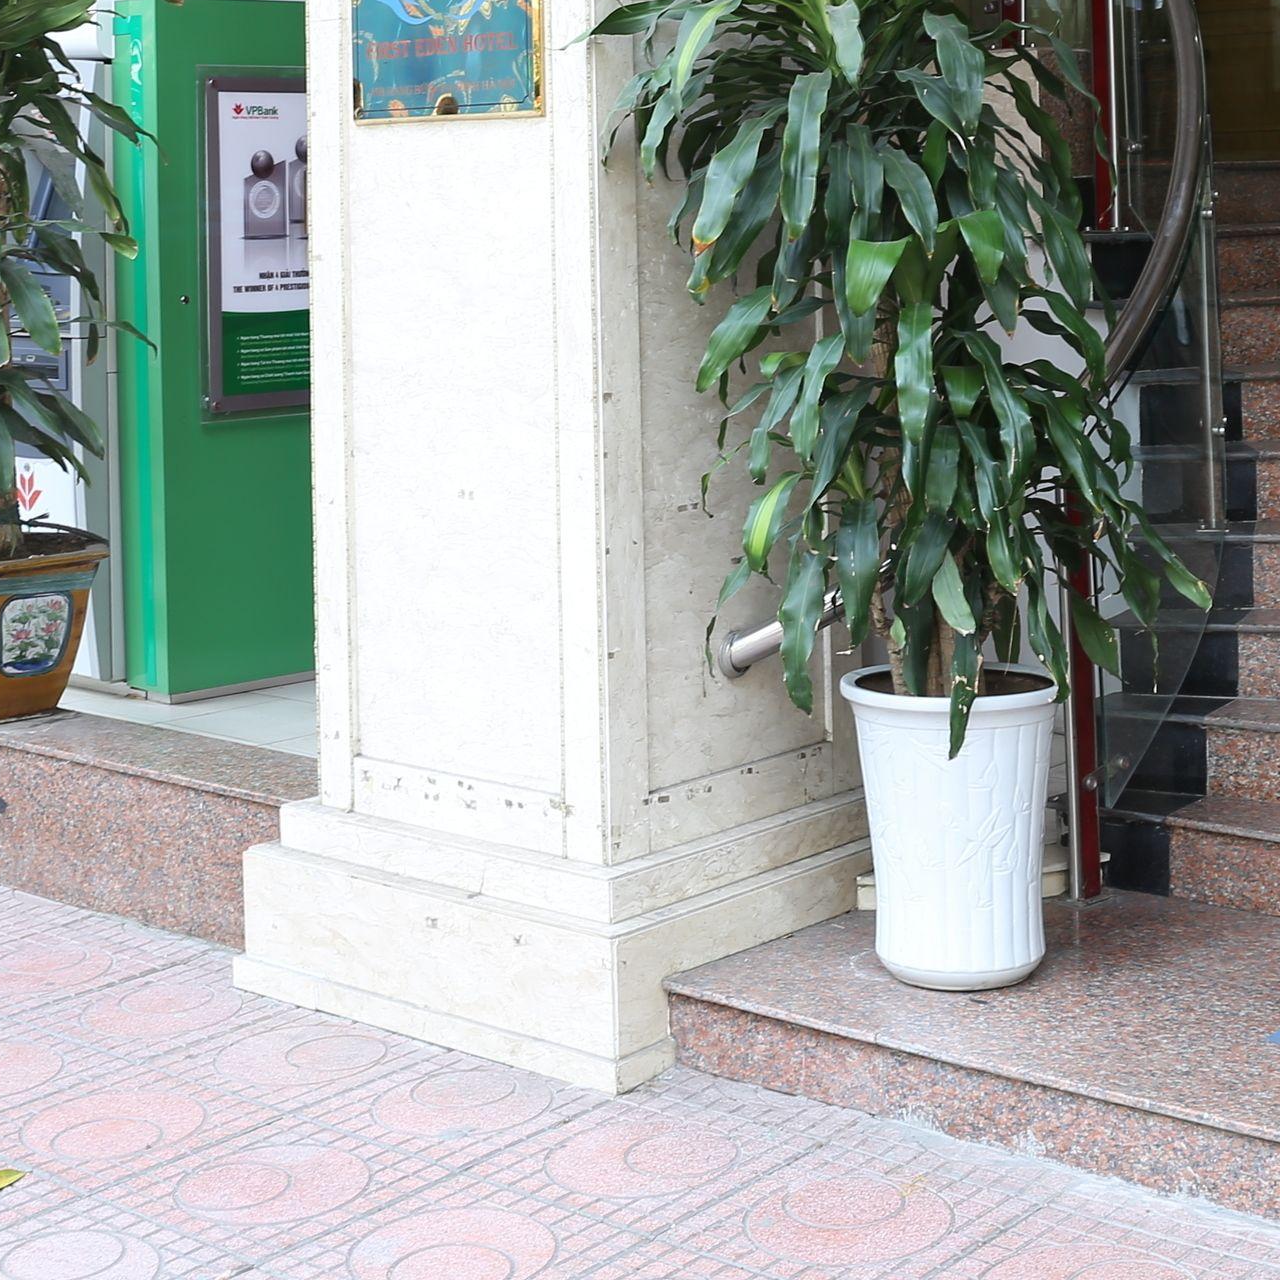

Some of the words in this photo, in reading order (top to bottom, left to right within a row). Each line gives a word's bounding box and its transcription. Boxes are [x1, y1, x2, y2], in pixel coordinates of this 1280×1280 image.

[366, 39, 411, 61] FIRST
[415, 35, 458, 58] EDEN
[463, 31, 519, 53] HOTEL
[245, 105, 280, 116] VPBank
[233, 285, 243, 293] THE
[244, 284, 266, 293] WINNER
[267, 283, 274, 292] OF
